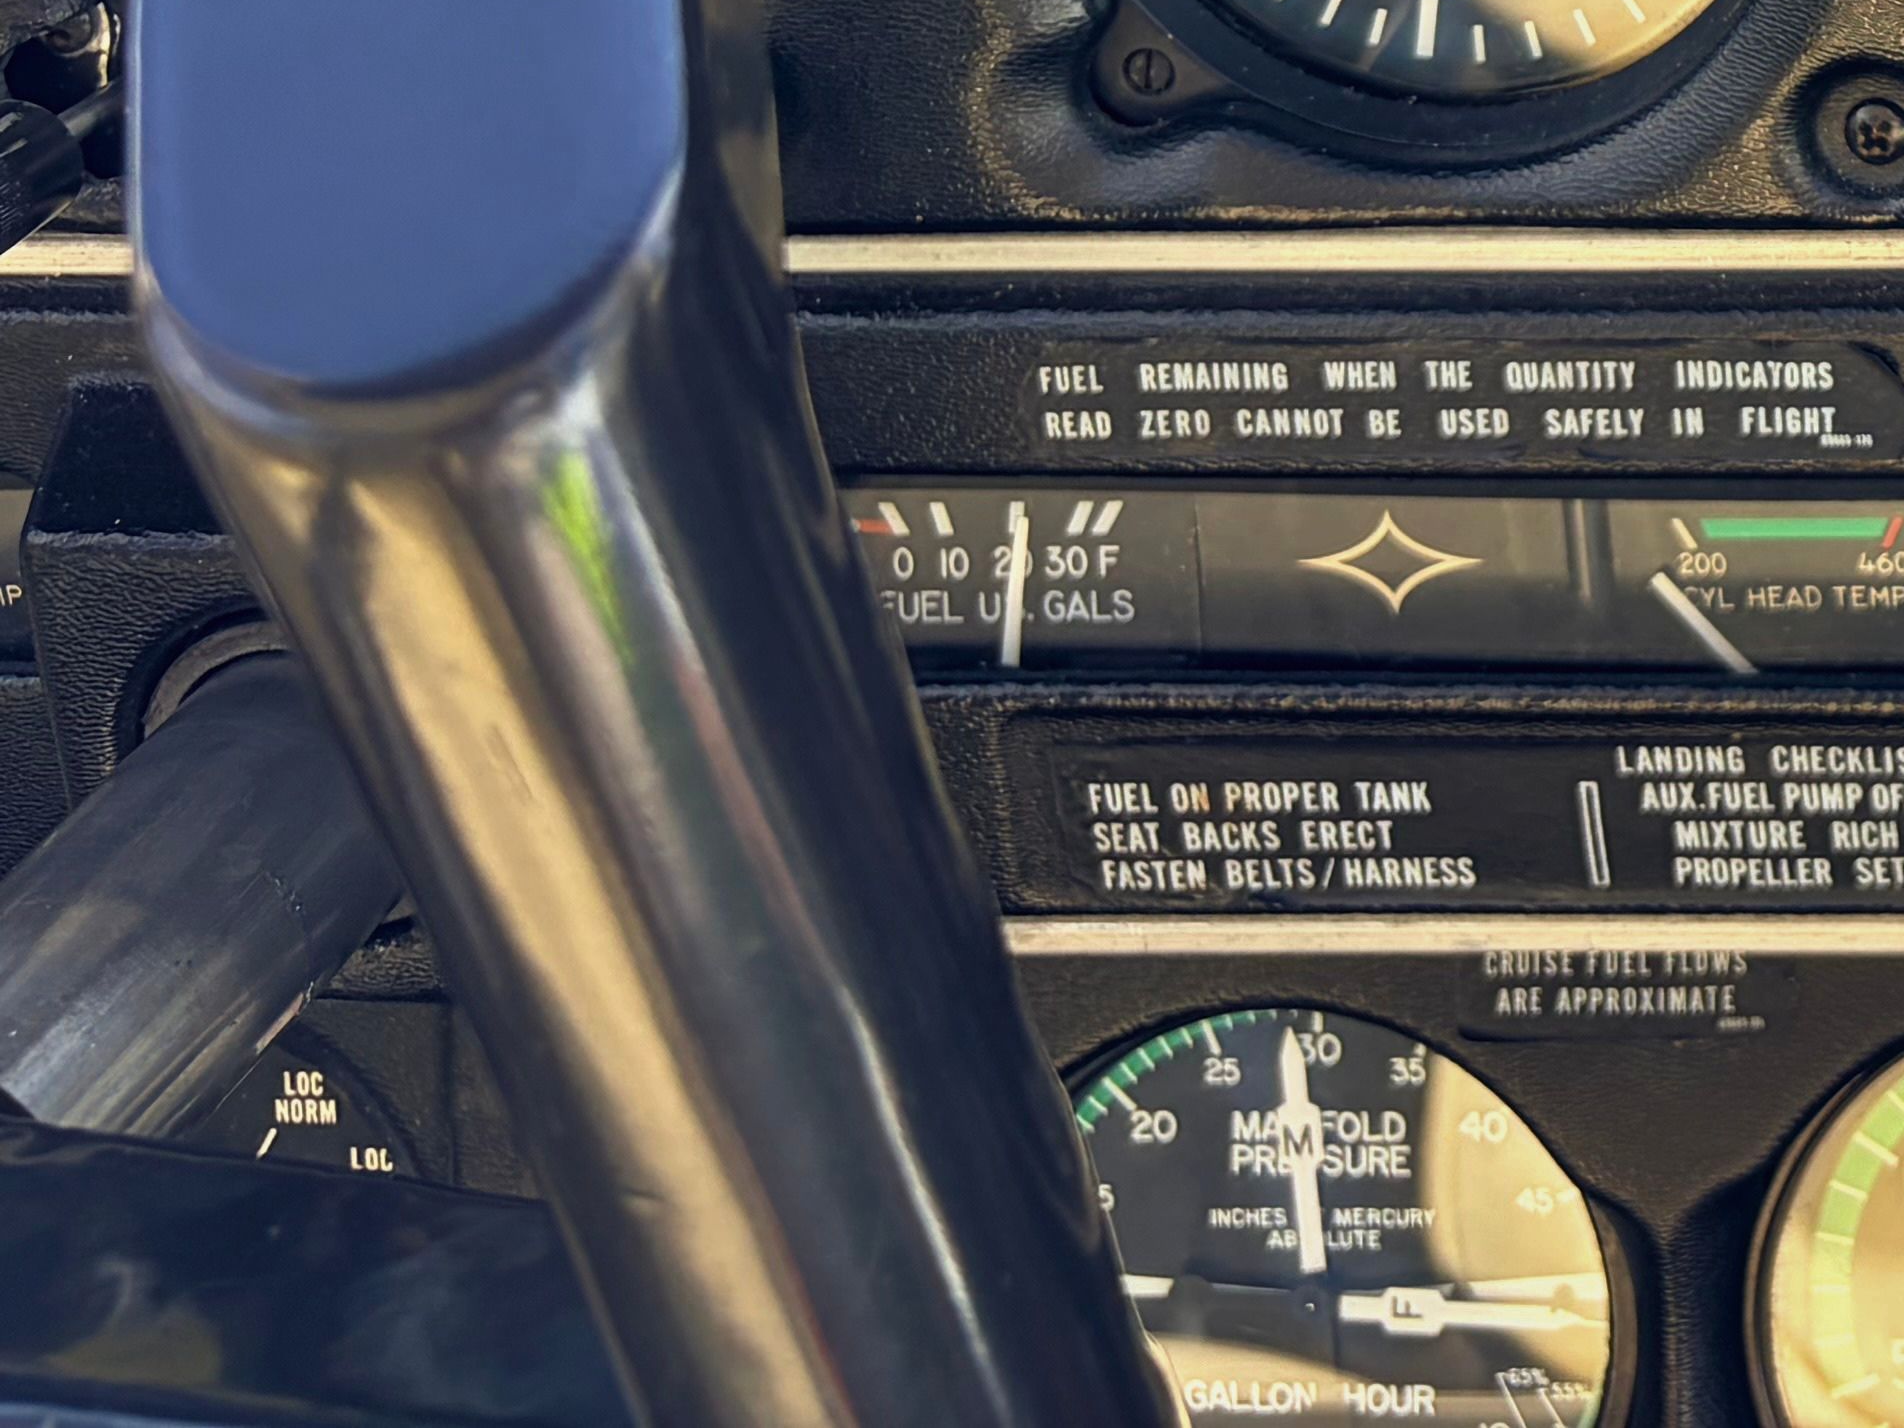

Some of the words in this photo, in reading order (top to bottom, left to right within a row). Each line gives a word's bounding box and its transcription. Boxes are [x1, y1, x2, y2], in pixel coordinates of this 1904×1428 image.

[1038, 366, 1104, 395] FUEL
[1139, 362, 1289, 392] REMAINING
[1323, 360, 1397, 391] WHEN
[1424, 360, 1473, 390] THE
[1504, 360, 1637, 391] QUANTITY
[1674, 360, 1835, 392] INDICATORS
[1616, 745, 1746, 777] LANDING
[1088, 781, 1158, 815] FUEL
[1171, 781, 1210, 815] ON
[1223, 781, 1340, 815] PROPER
[1355, 780, 1433, 813] TANK
[1092, 820, 1161, 854] SEAT
[1181, 819, 1280, 853] BACKS
[1301, 819, 1394, 851] ERECT
[283, 1070, 324, 1098] LOC
[275, 1098, 337, 1127] NORM
